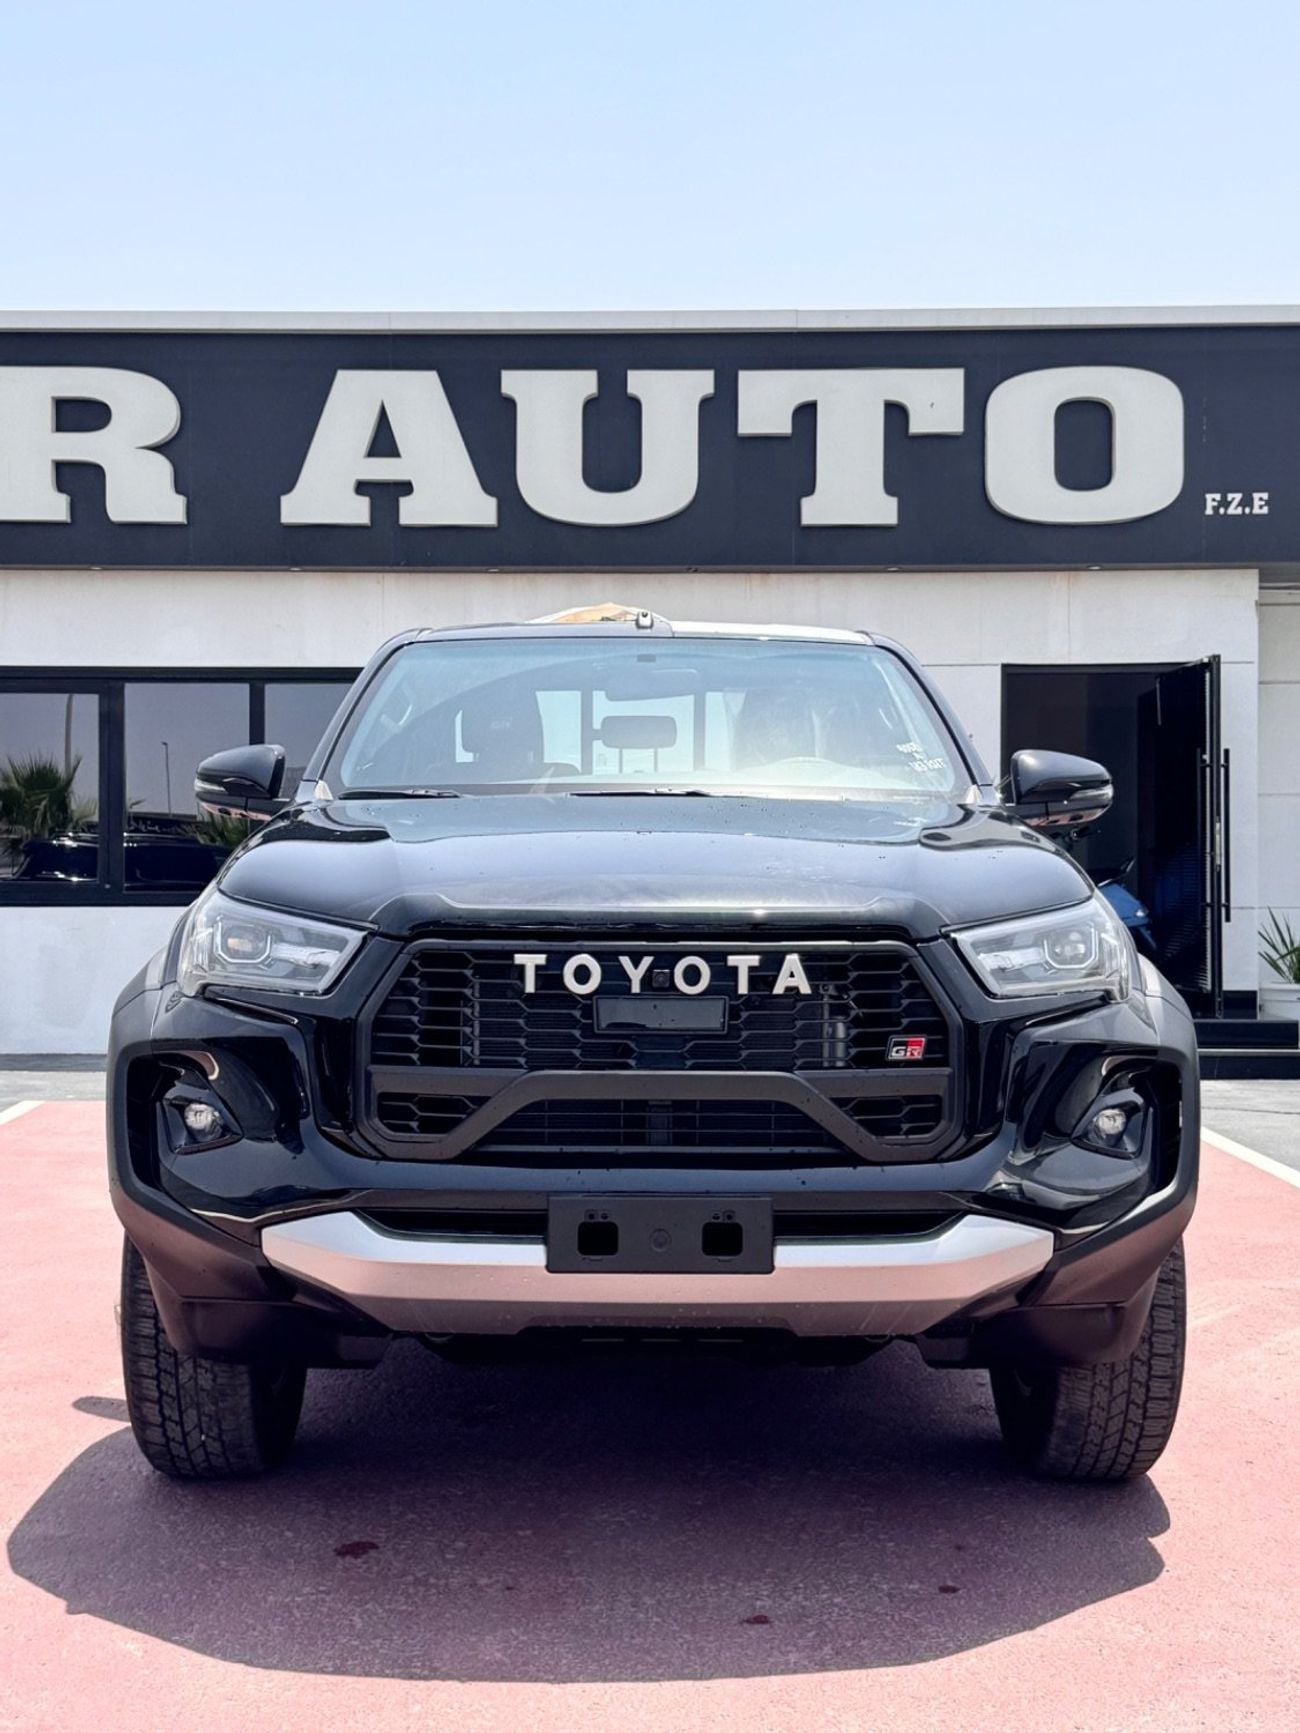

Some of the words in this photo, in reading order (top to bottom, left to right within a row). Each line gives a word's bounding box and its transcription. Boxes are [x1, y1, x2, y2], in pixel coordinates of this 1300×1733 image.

[0, 367, 186, 523] R
[281, 367, 1184, 525] AUTO
[1205, 493, 1268, 514] F.Z.E
[515, 954, 811, 994] TOYOTA
[891, 1046, 921, 1057] GR
